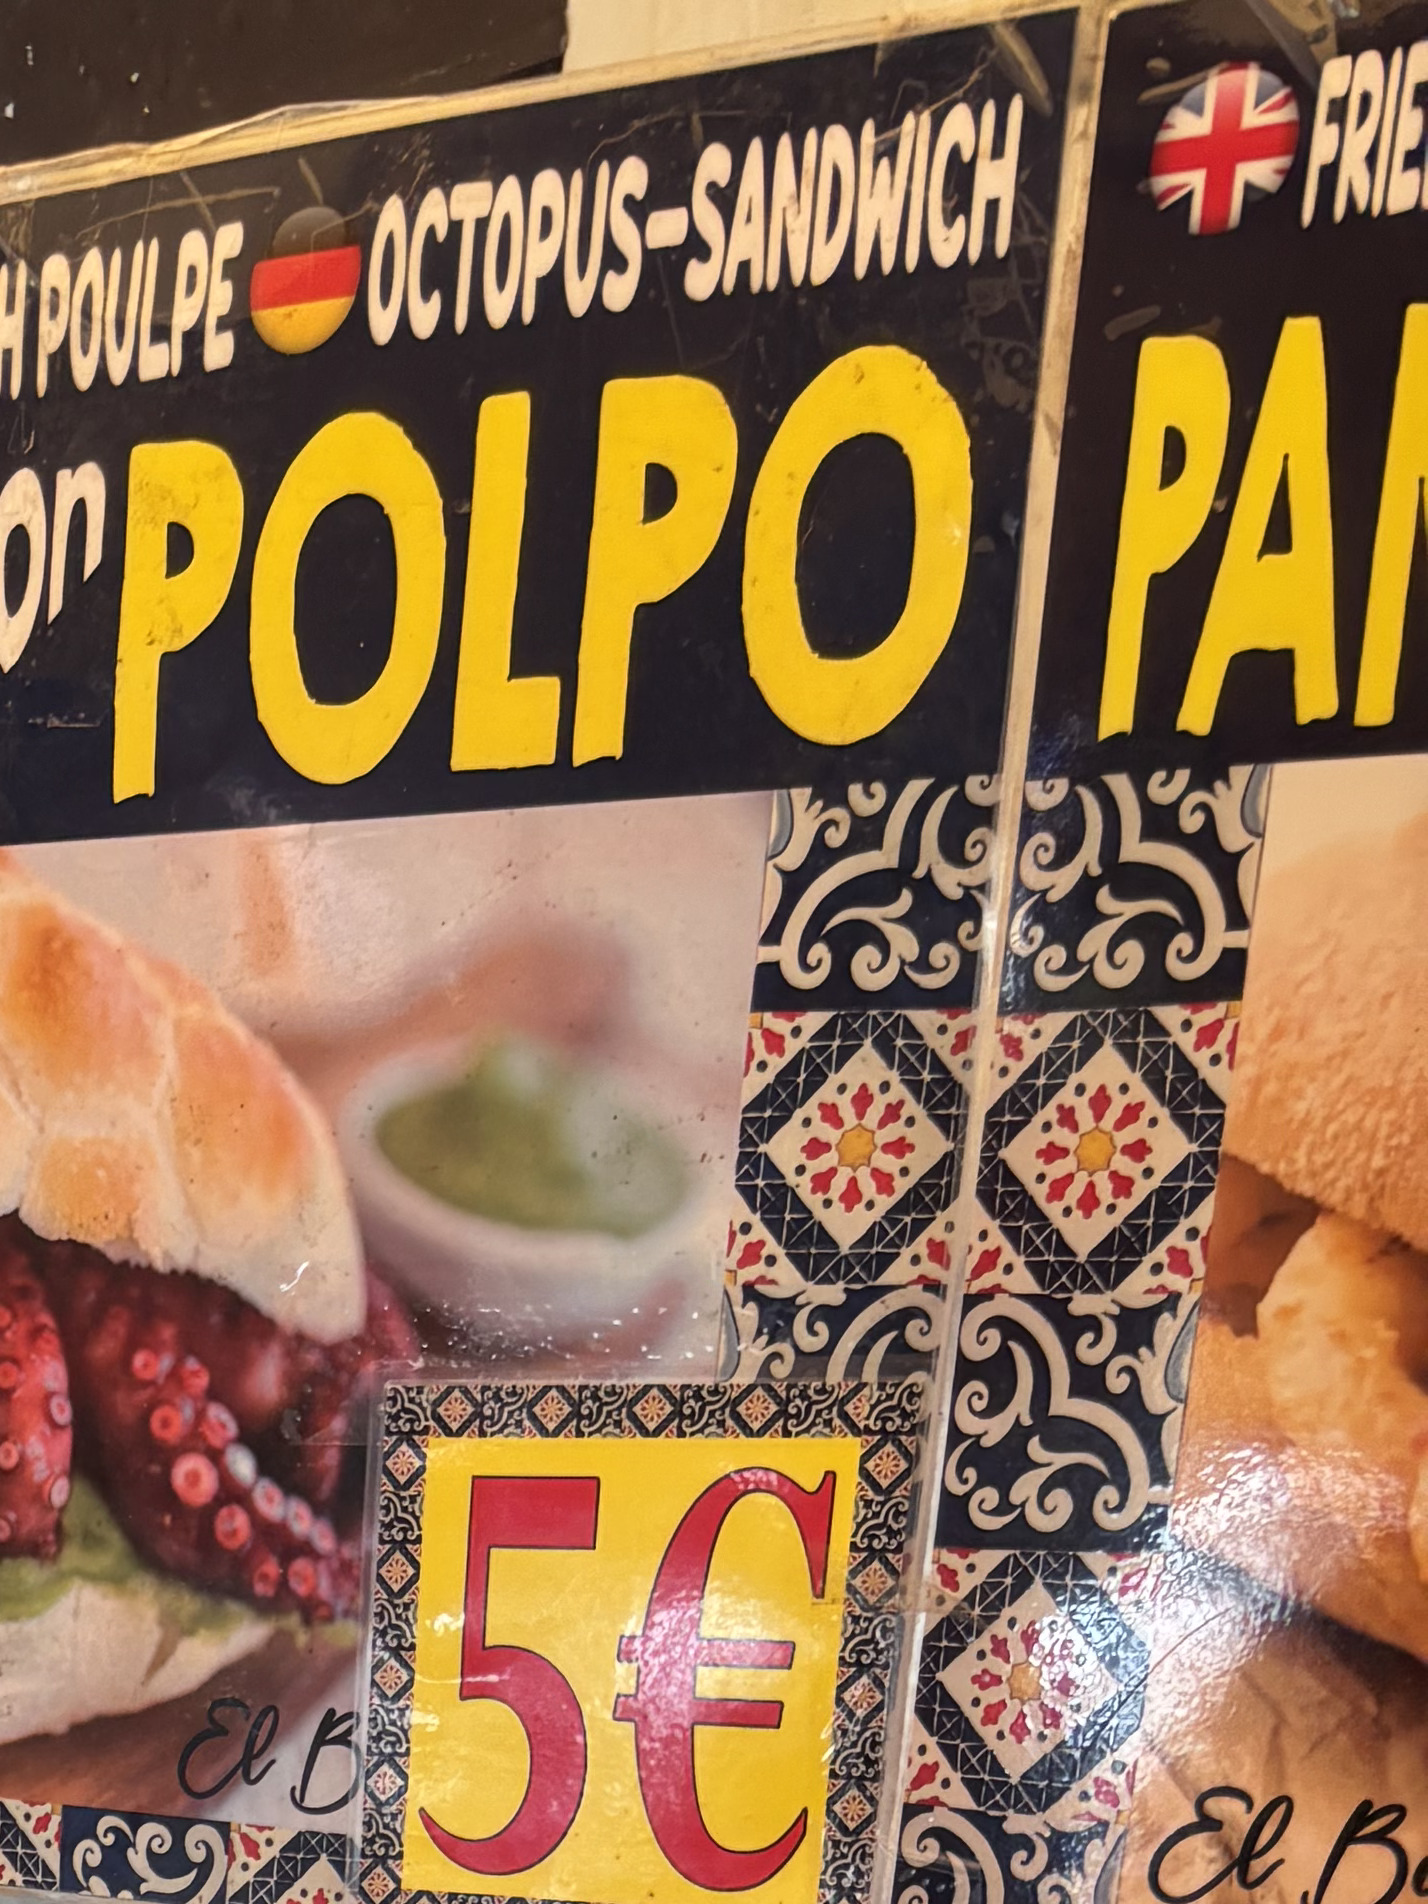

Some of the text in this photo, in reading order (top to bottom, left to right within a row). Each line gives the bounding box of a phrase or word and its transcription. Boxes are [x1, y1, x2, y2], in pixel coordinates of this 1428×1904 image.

[38, 221, 242, 399] POULPE
[366, 93, 1022, 346] OCTOPUS-SANDWICH
[1301, 40, 1428, 229] FRIE
[113, 343, 975, 807] POLPO
[178, 1697, 276, 1799] El
[419, 1466, 837, 1891] 5€
[1149, 1786, 1294, 1904] El
